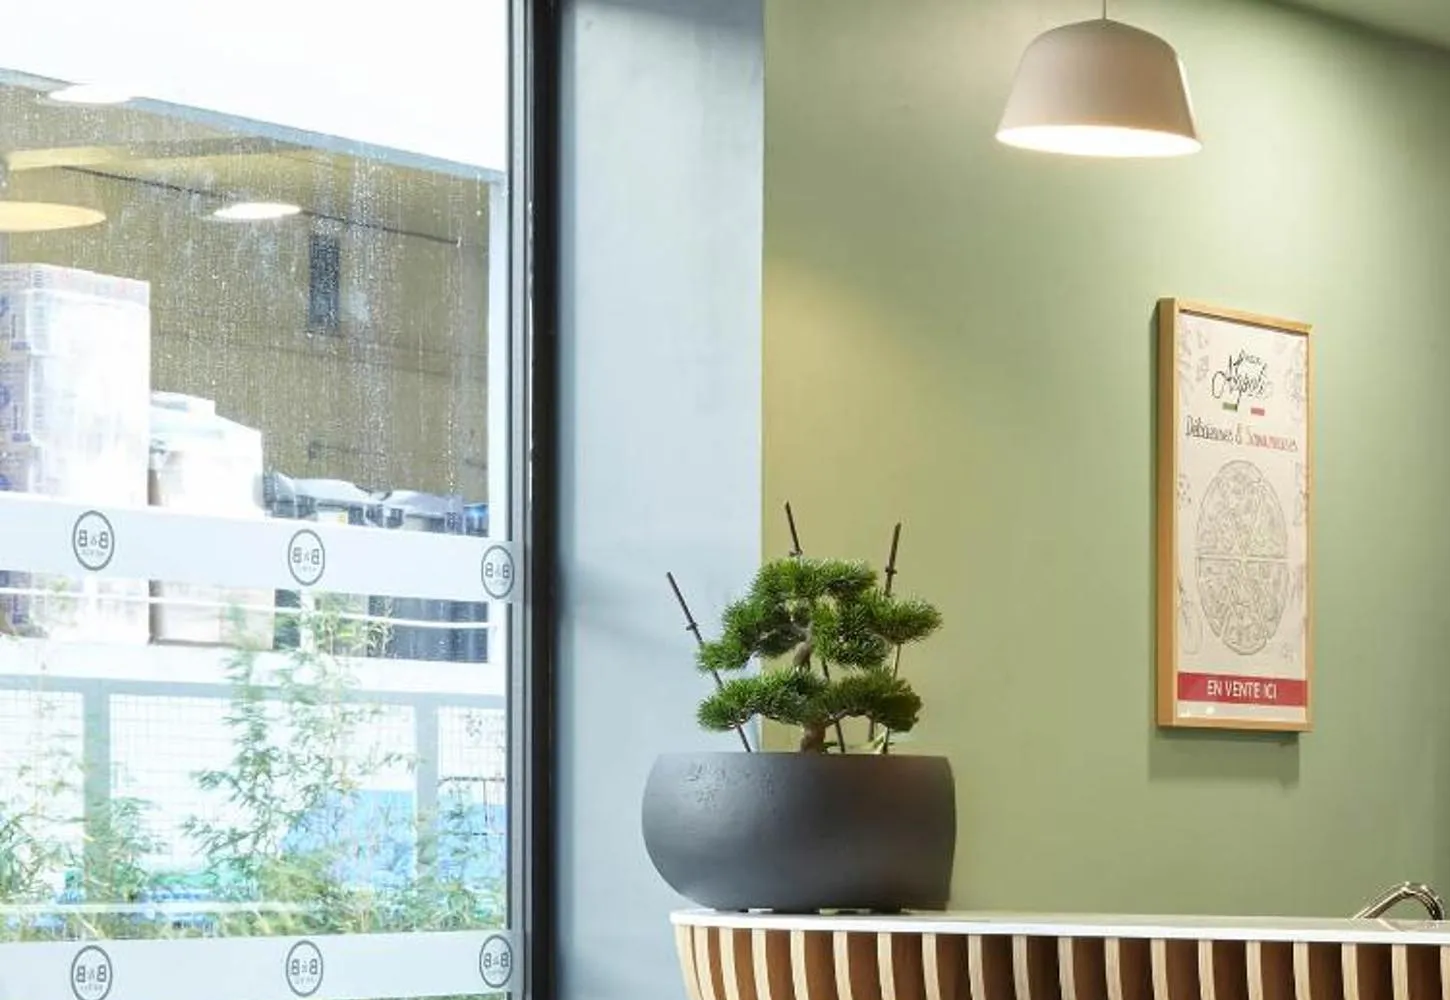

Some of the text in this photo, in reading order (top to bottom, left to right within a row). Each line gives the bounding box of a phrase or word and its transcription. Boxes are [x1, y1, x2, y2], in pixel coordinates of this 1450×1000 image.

[1207, 680, 1277, 699] EN VENTE ICI
